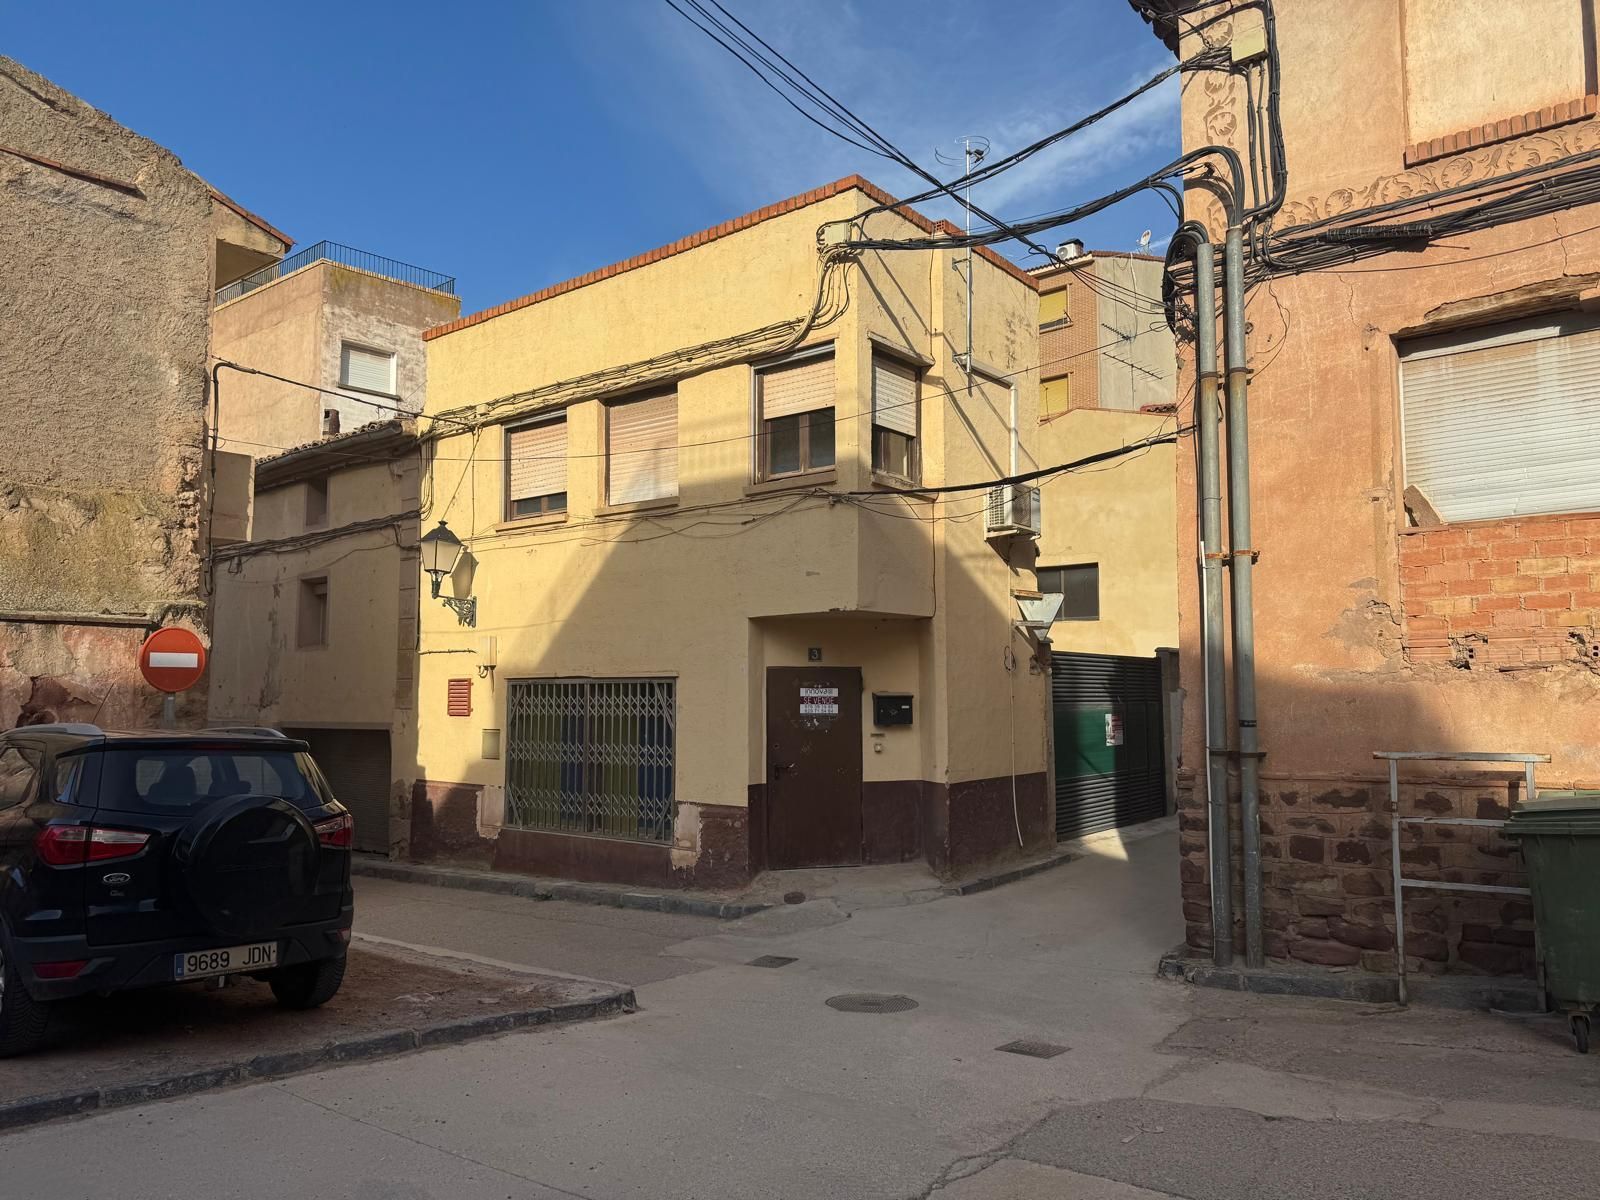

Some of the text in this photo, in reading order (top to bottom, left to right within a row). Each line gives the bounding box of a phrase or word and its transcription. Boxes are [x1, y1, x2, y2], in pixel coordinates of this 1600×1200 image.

[811, 649, 819, 660] 3
[803, 696, 834, 704] SE VENDE
[187, 945, 272, 973] 9689 JDN
